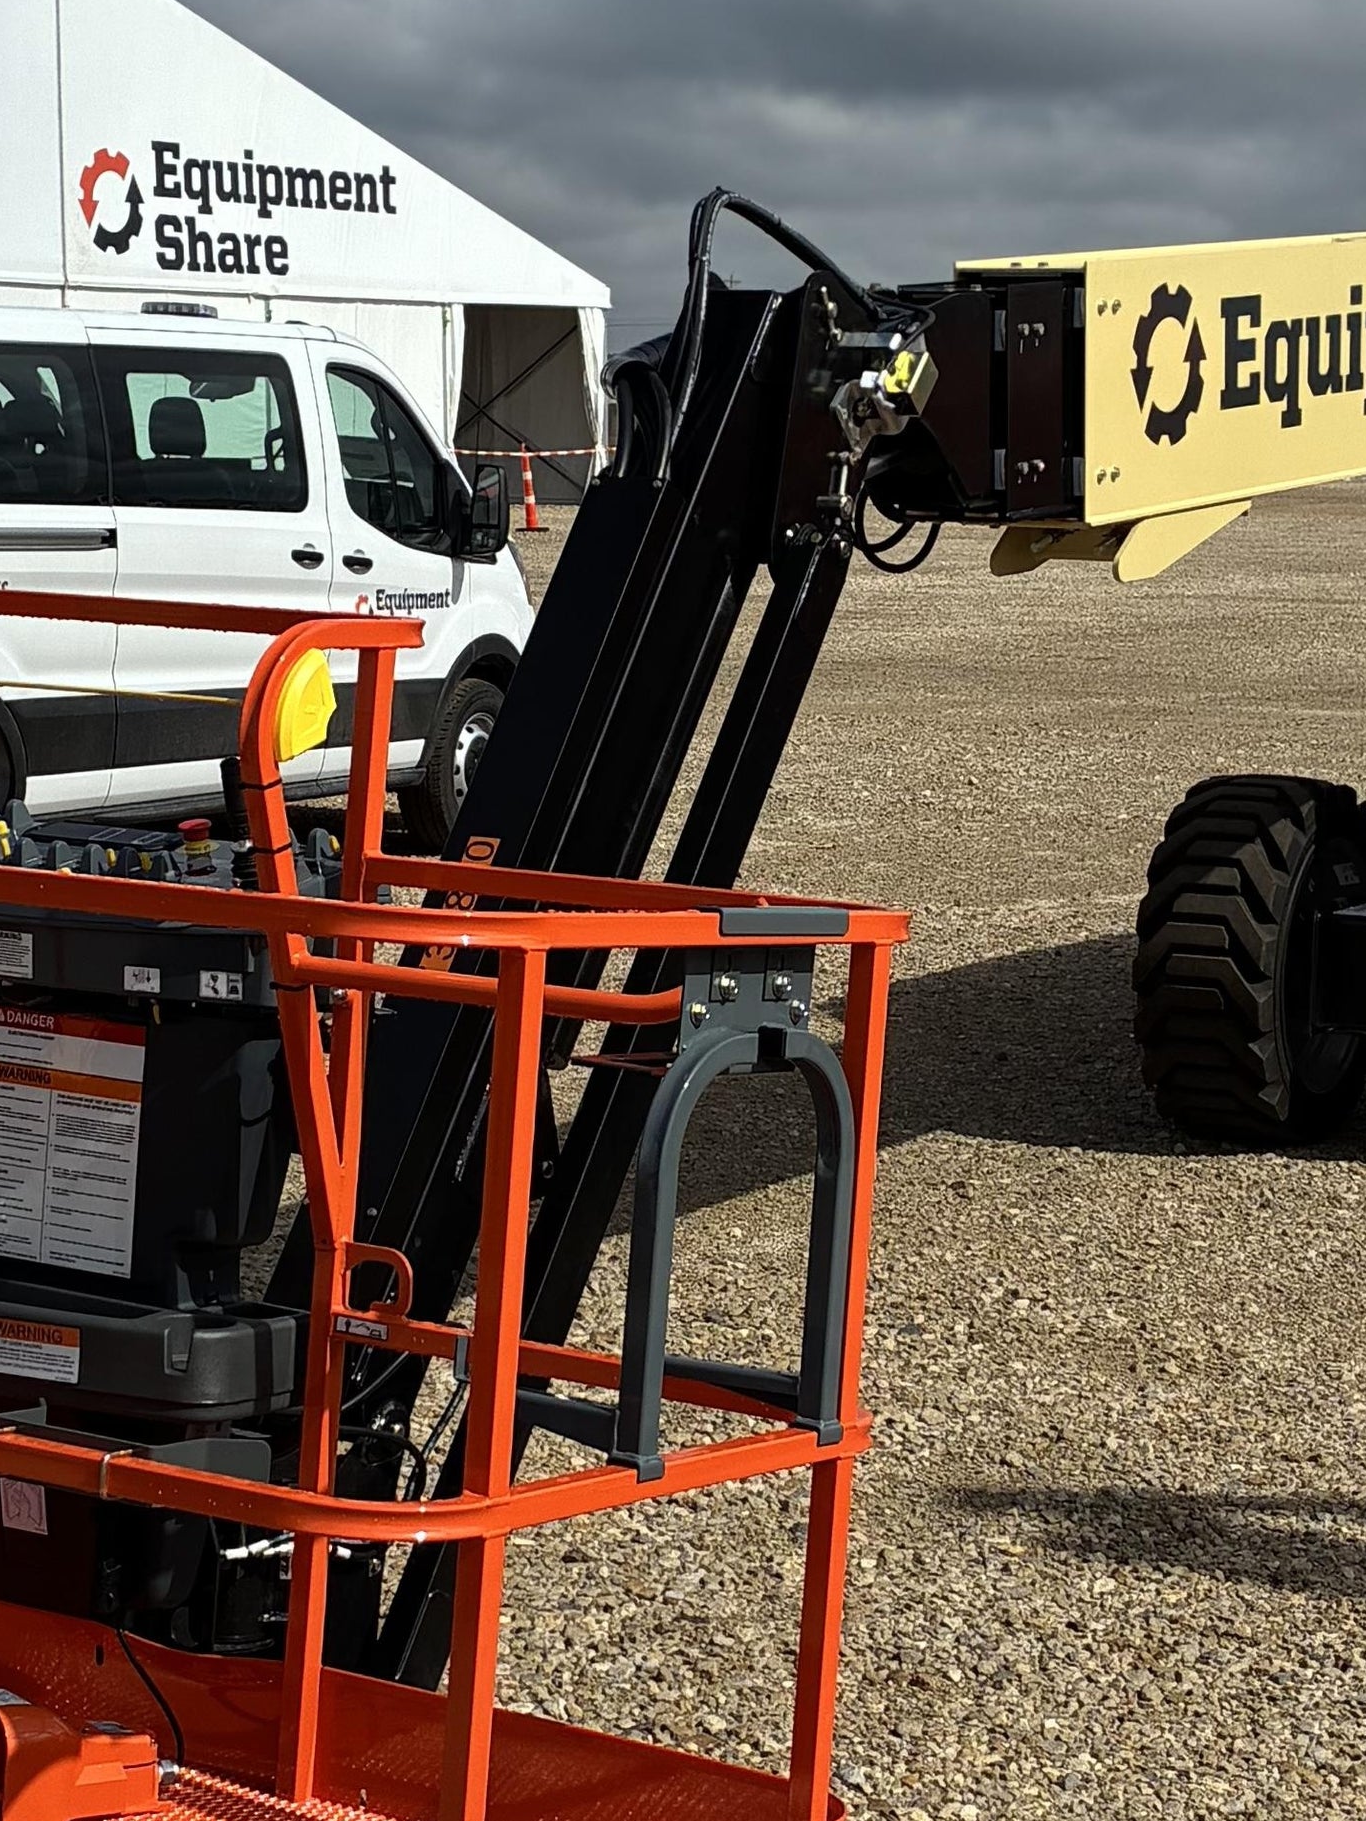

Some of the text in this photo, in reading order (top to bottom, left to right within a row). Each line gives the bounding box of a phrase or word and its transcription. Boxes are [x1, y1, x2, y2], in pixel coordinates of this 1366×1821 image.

[151, 140, 397, 219] Equipment
[154, 213, 289, 276] Share
[375, 587, 451, 616] Equipment
[6, 1009, 55, 1029] DANGER
